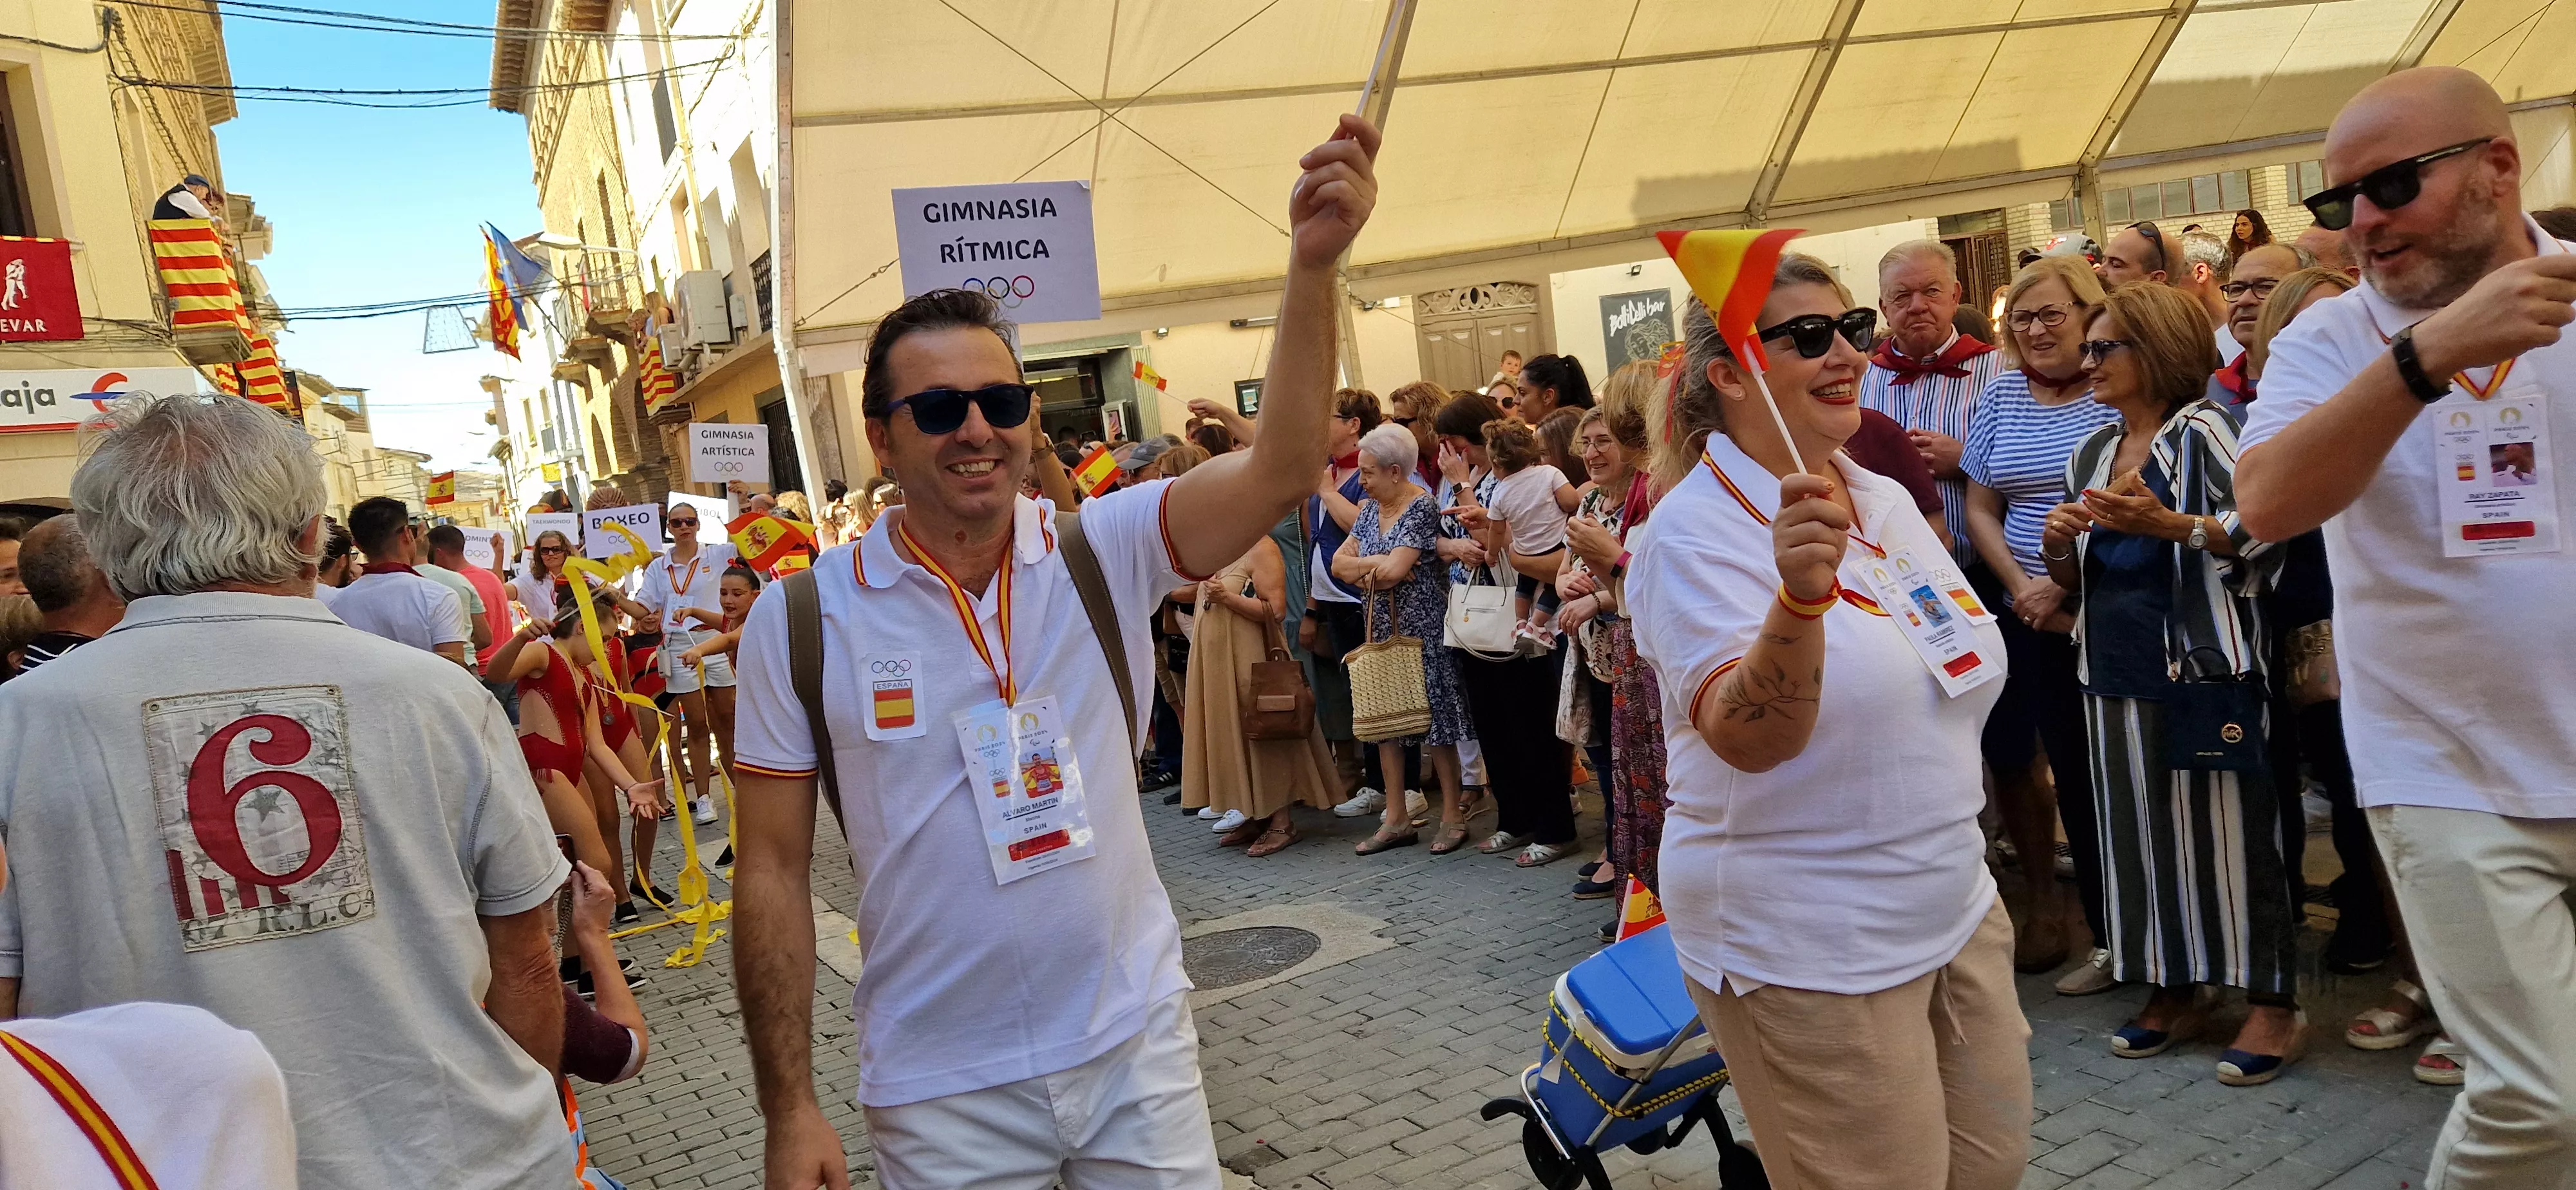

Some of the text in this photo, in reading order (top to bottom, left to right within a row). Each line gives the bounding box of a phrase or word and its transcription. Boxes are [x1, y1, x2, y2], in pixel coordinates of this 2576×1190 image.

[923, 198, 1057, 223] GIMNASIA
[940, 236, 1050, 263] RÍTMICA
[1646, 297, 1666, 316] bar
[0, 380, 57, 414] aja
[701, 430, 754, 439] GIMNASIA
[701, 444, 755, 456] ARTÍSTICA
[876, 681, 909, 689] ESPAÑA
[187, 713, 343, 887] 6
[1002, 797, 1059, 818] ALVARO MARTIN
[1024, 822, 1047, 834] SPAIN
